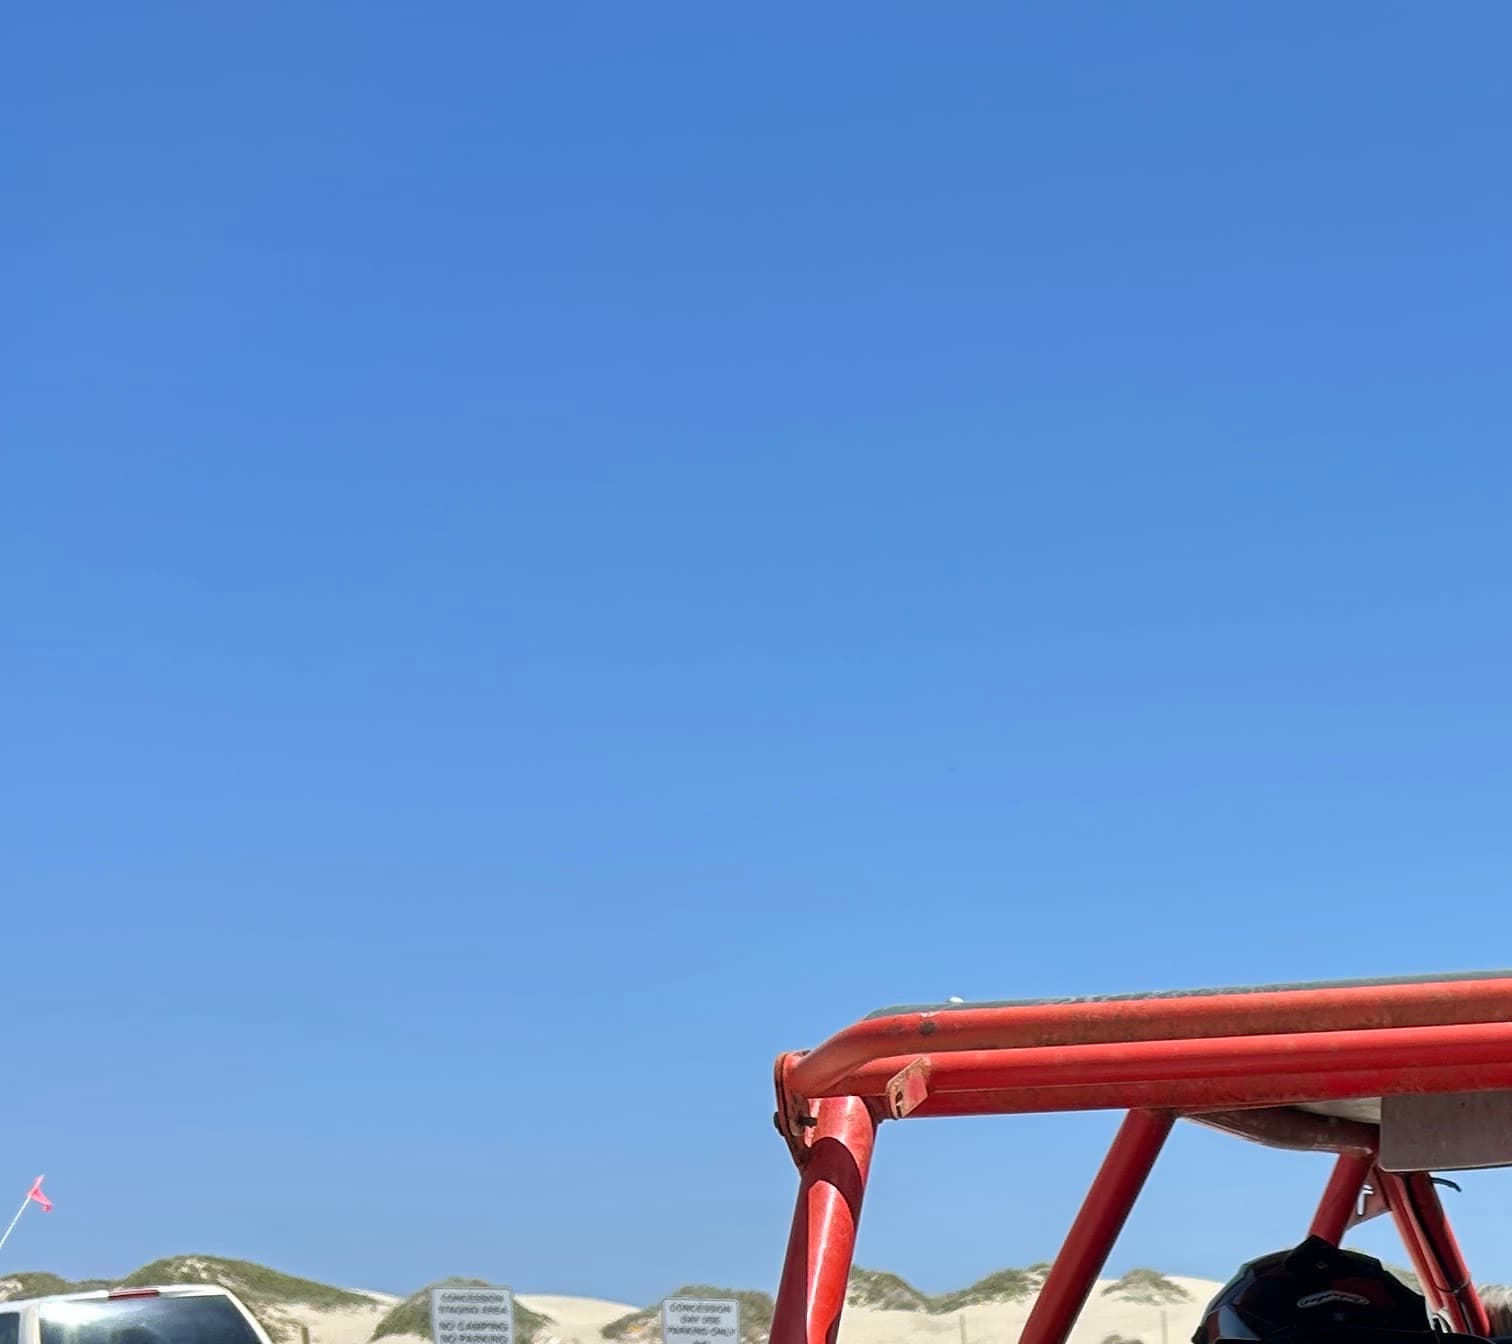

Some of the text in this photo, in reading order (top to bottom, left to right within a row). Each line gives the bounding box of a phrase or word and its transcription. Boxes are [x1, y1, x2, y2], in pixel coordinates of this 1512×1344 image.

[439, 1321, 509, 1333] NO CAMPING
[440, 1334, 509, 1344] NO PARKING
